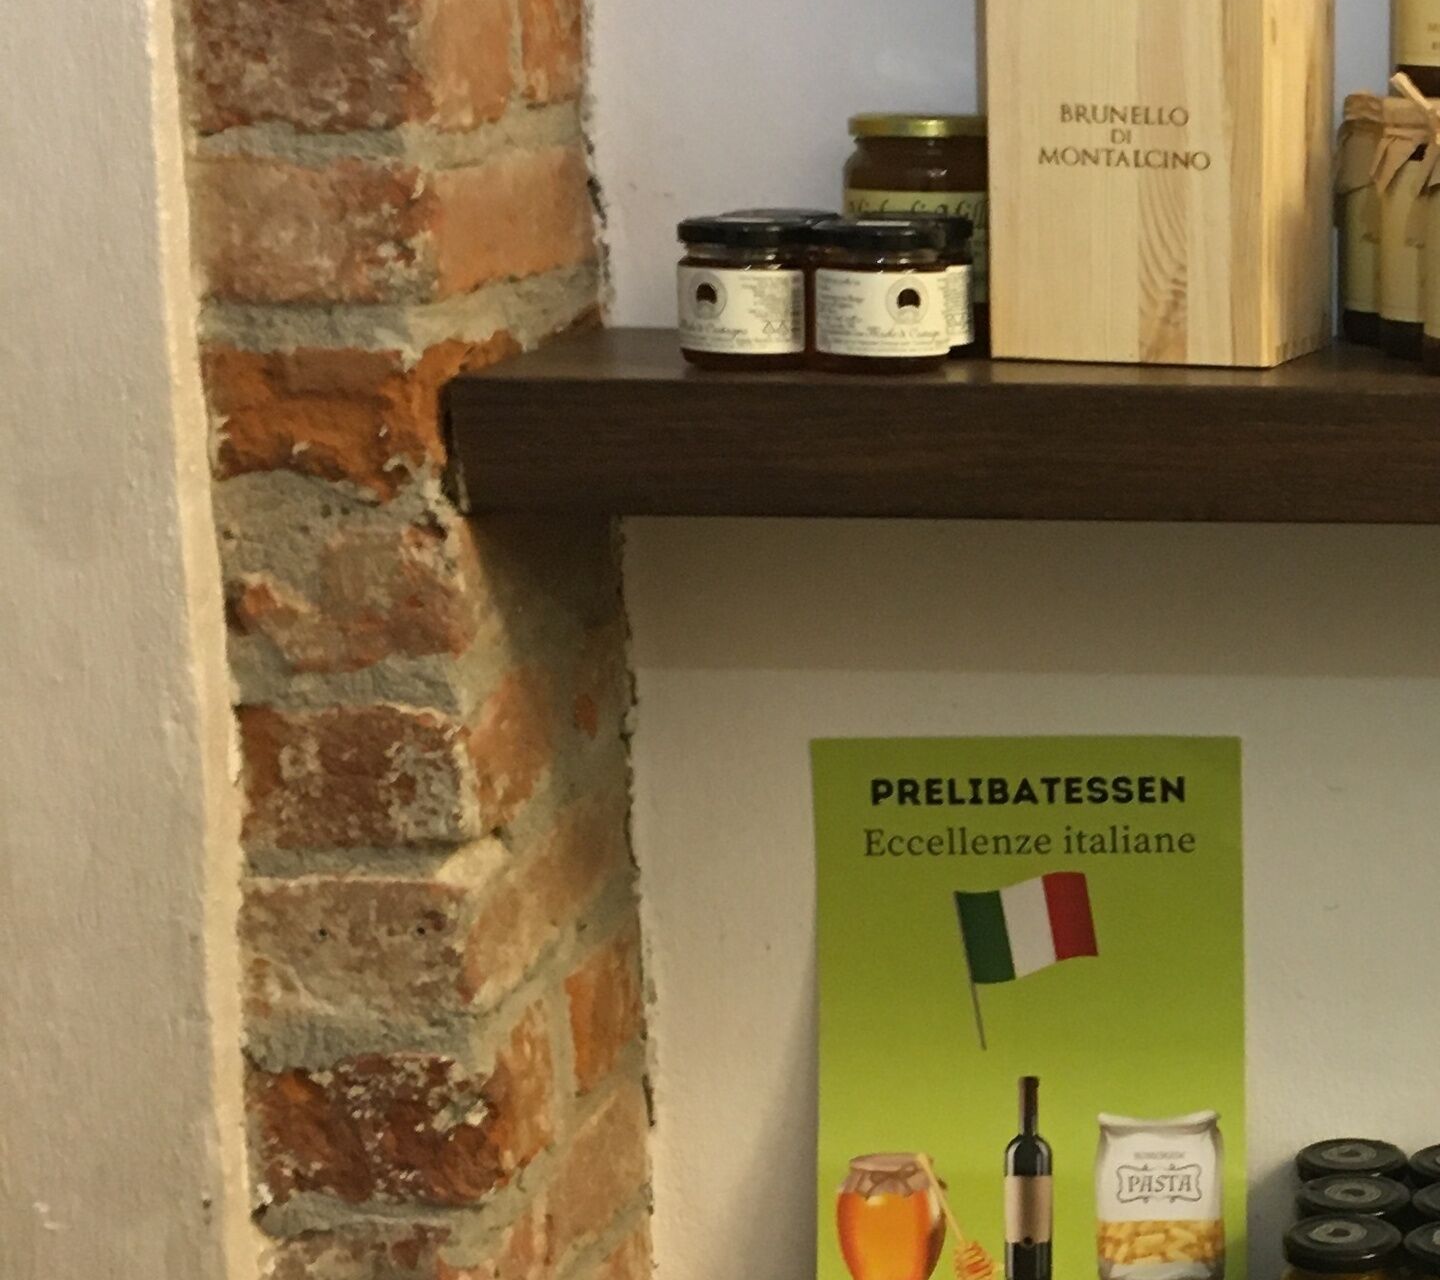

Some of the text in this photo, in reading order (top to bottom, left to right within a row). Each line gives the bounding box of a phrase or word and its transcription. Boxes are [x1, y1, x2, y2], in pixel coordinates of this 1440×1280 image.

[1059, 103, 1189, 127] BRUNELLO
[1110, 129, 1132, 145] DI
[1037, 147, 1212, 172] MONTALCINO
[870, 776, 1186, 806] PRELIBATESSEN
[864, 824, 1197, 858] Eccellenze italiane
[1127, 1174, 1192, 1193] PASTA
